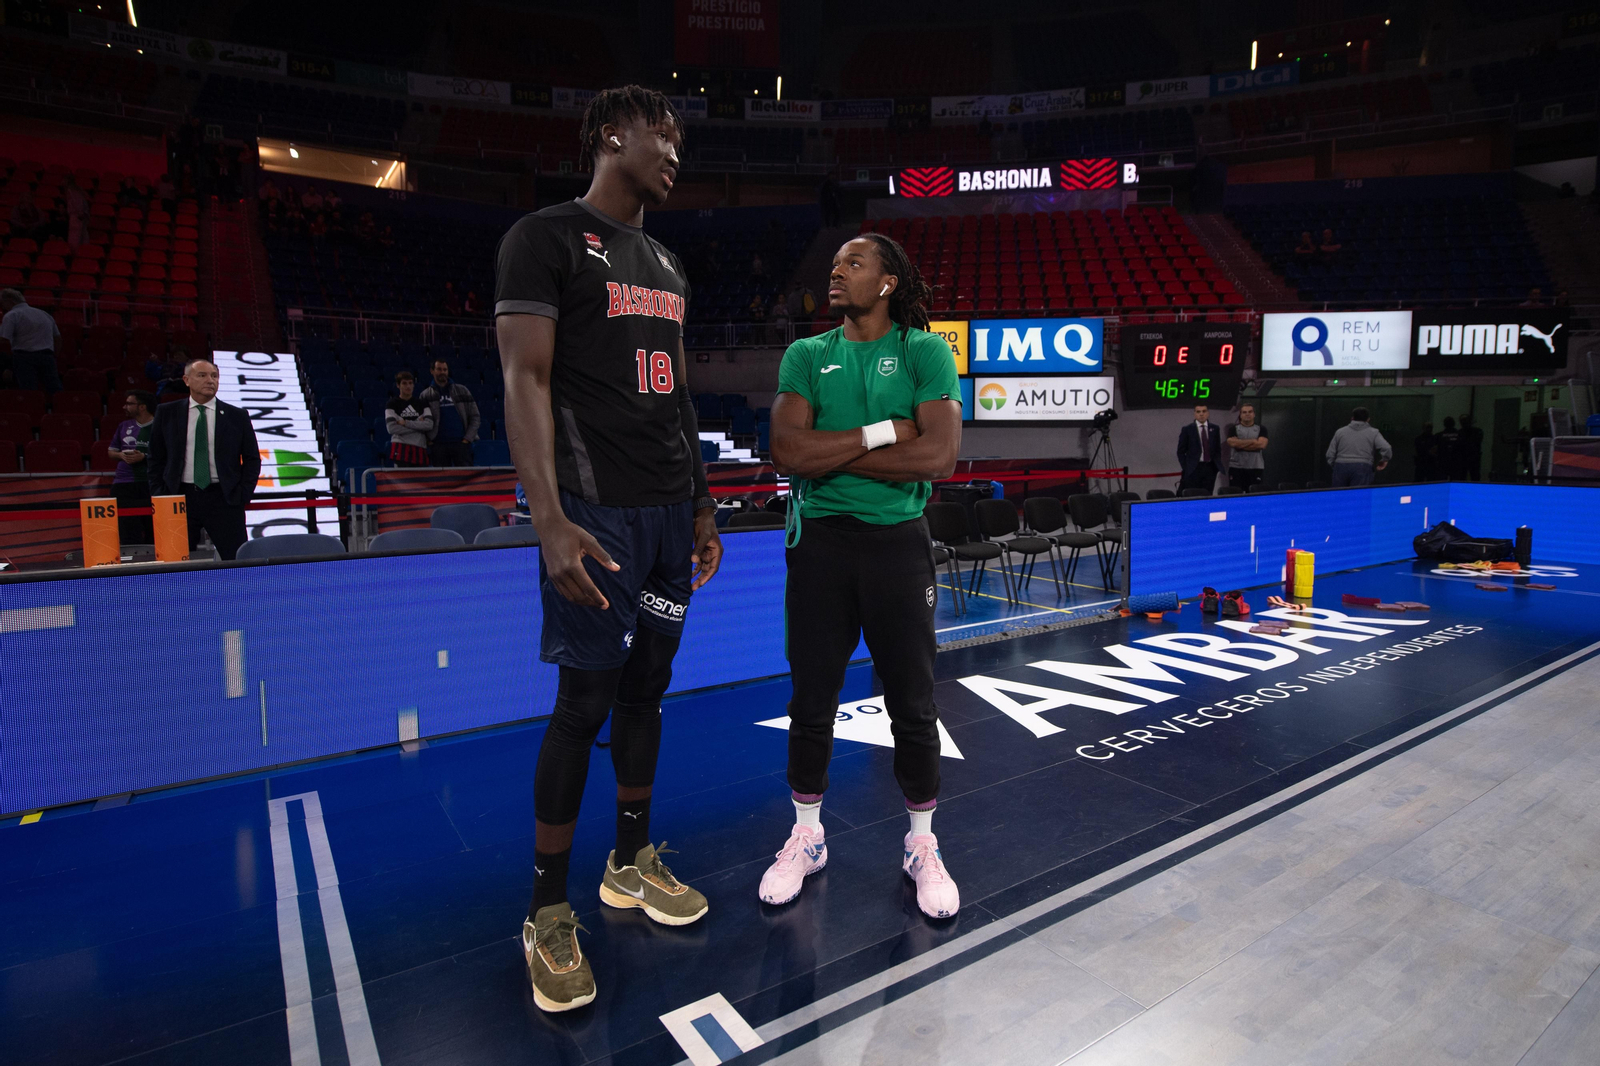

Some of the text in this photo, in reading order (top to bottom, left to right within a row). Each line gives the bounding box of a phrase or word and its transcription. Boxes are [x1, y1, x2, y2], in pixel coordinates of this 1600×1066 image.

[692, 0, 762, 14] PRESTIGIO
[687, 14, 766, 31] PRESTIGIOA
[291, 60, 331, 76] 315-A
[1154, 80, 1189, 97] JUPER
[1217, 67, 1291, 92] DIGI
[751, 99, 814, 114] Metalkor
[1024, 96, 1045, 108] Cruz
[1046, 94, 1072, 106] Araba
[934, 108, 1004, 117] JULKER
[958, 167, 1052, 192] BASKONIA
[1122, 163, 1140, 184] B
[1204, 331, 1233, 339] KANPOKOA
[1342, 320, 1380, 334] REM
[973, 323, 1100, 367] IMQ
[1342, 338, 1380, 352] IRU
[1417, 323, 1520, 356] PUMA
[1153, 344, 1168, 366] 0
[1219, 343, 1234, 365] 0
[635, 348, 675, 394] 18
[235, 351, 298, 438] AMUTIO
[1015, 388, 1111, 406] AMUTIO
[1154, 378, 1211, 399] 46:15
[87, 504, 116, 519] IRS
[956, 606, 1430, 739] AMBAR
[1076, 623, 1484, 762] CERVECEROS INDEPENDIENTES
